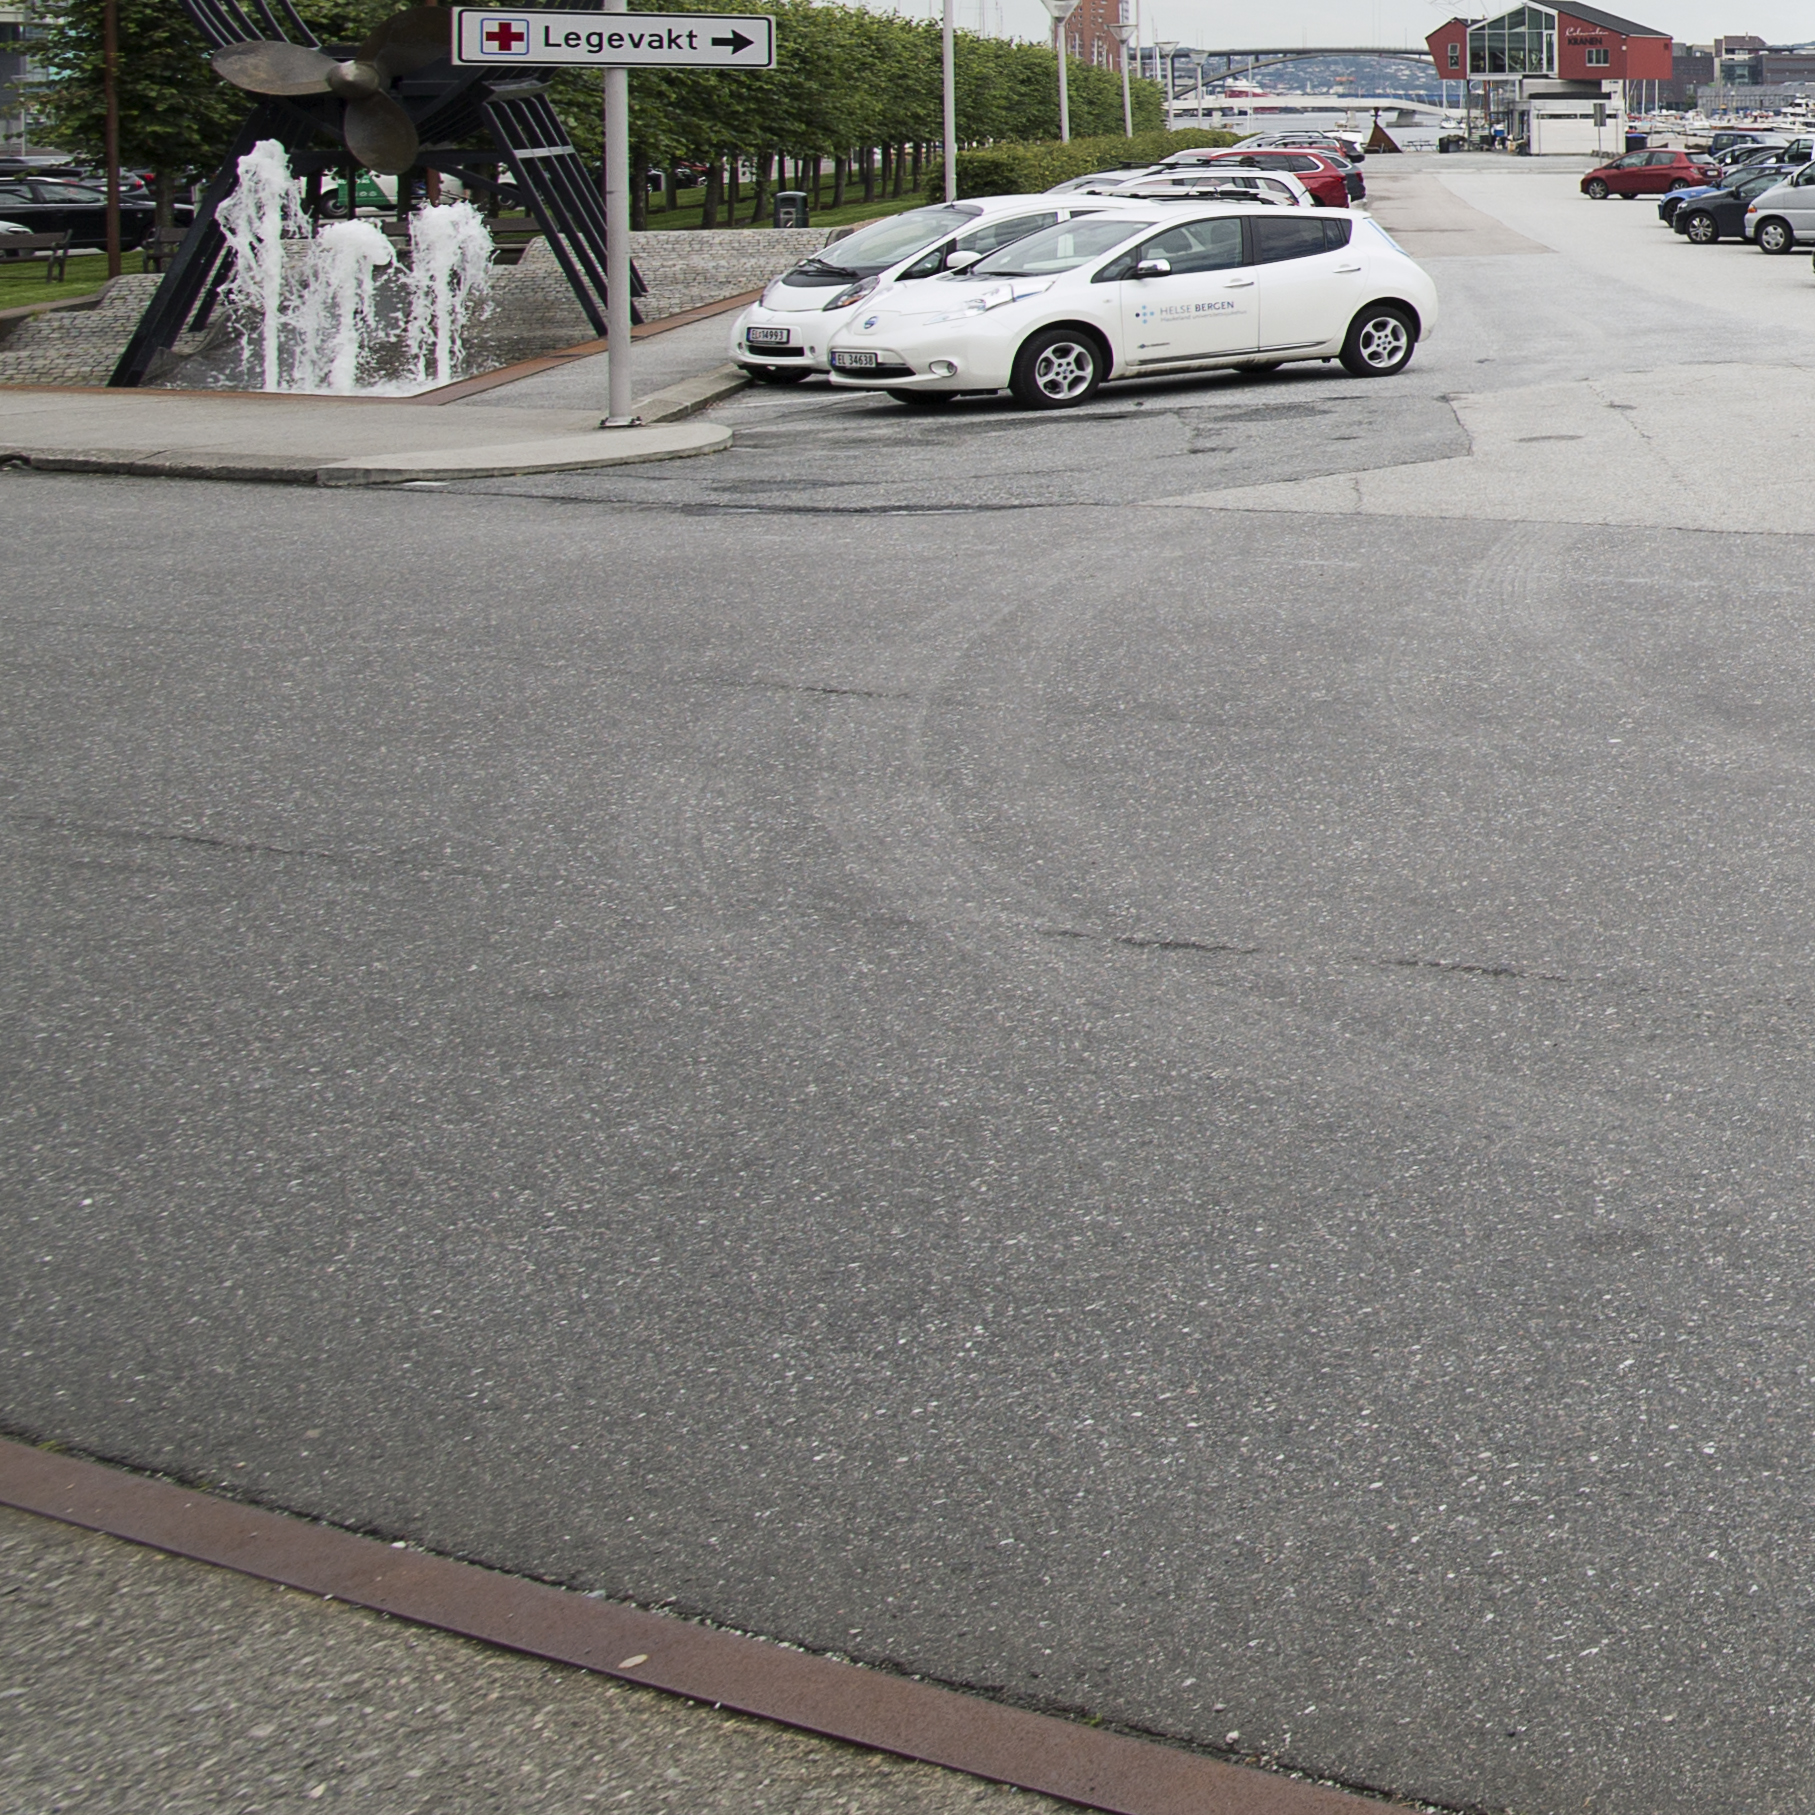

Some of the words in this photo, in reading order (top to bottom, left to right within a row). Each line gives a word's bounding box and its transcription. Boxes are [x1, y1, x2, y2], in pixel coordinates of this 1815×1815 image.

[543, 24, 699, 54] Legevakt
[1567, 37, 1602, 45] KRANEN
[1160, 304, 1192, 315] HELSE
[1195, 301, 1235, 312] BERGEN
[761, 330, 784, 341] 14993
[837, 354, 846, 364] EL
[848, 354, 874, 364] 34638
